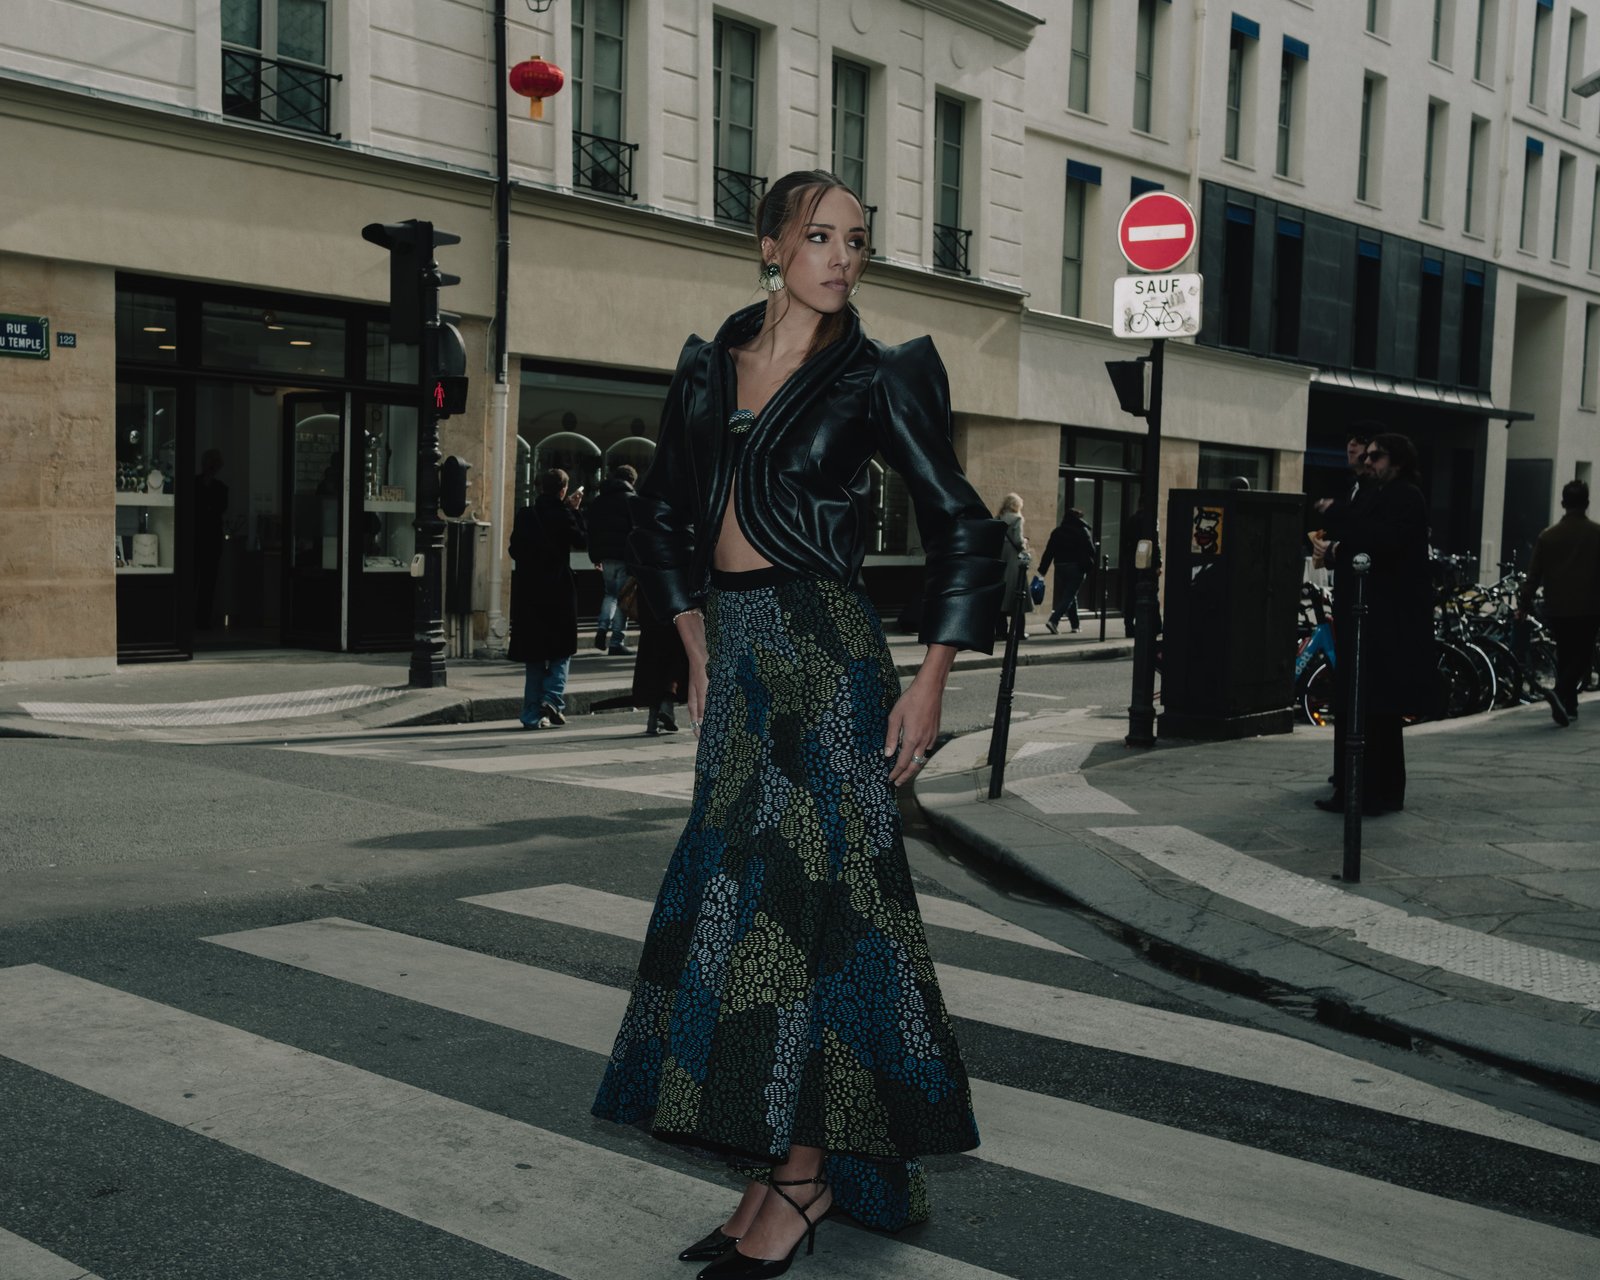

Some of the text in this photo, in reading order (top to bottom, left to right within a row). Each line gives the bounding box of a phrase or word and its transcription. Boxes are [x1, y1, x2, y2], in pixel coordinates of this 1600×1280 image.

[1135, 279, 1180, 295] SAUF
[6, 323, 28, 335] RUE
[0, 336, 41, 349] U TEMPLE
[59, 335, 74, 345] 122
